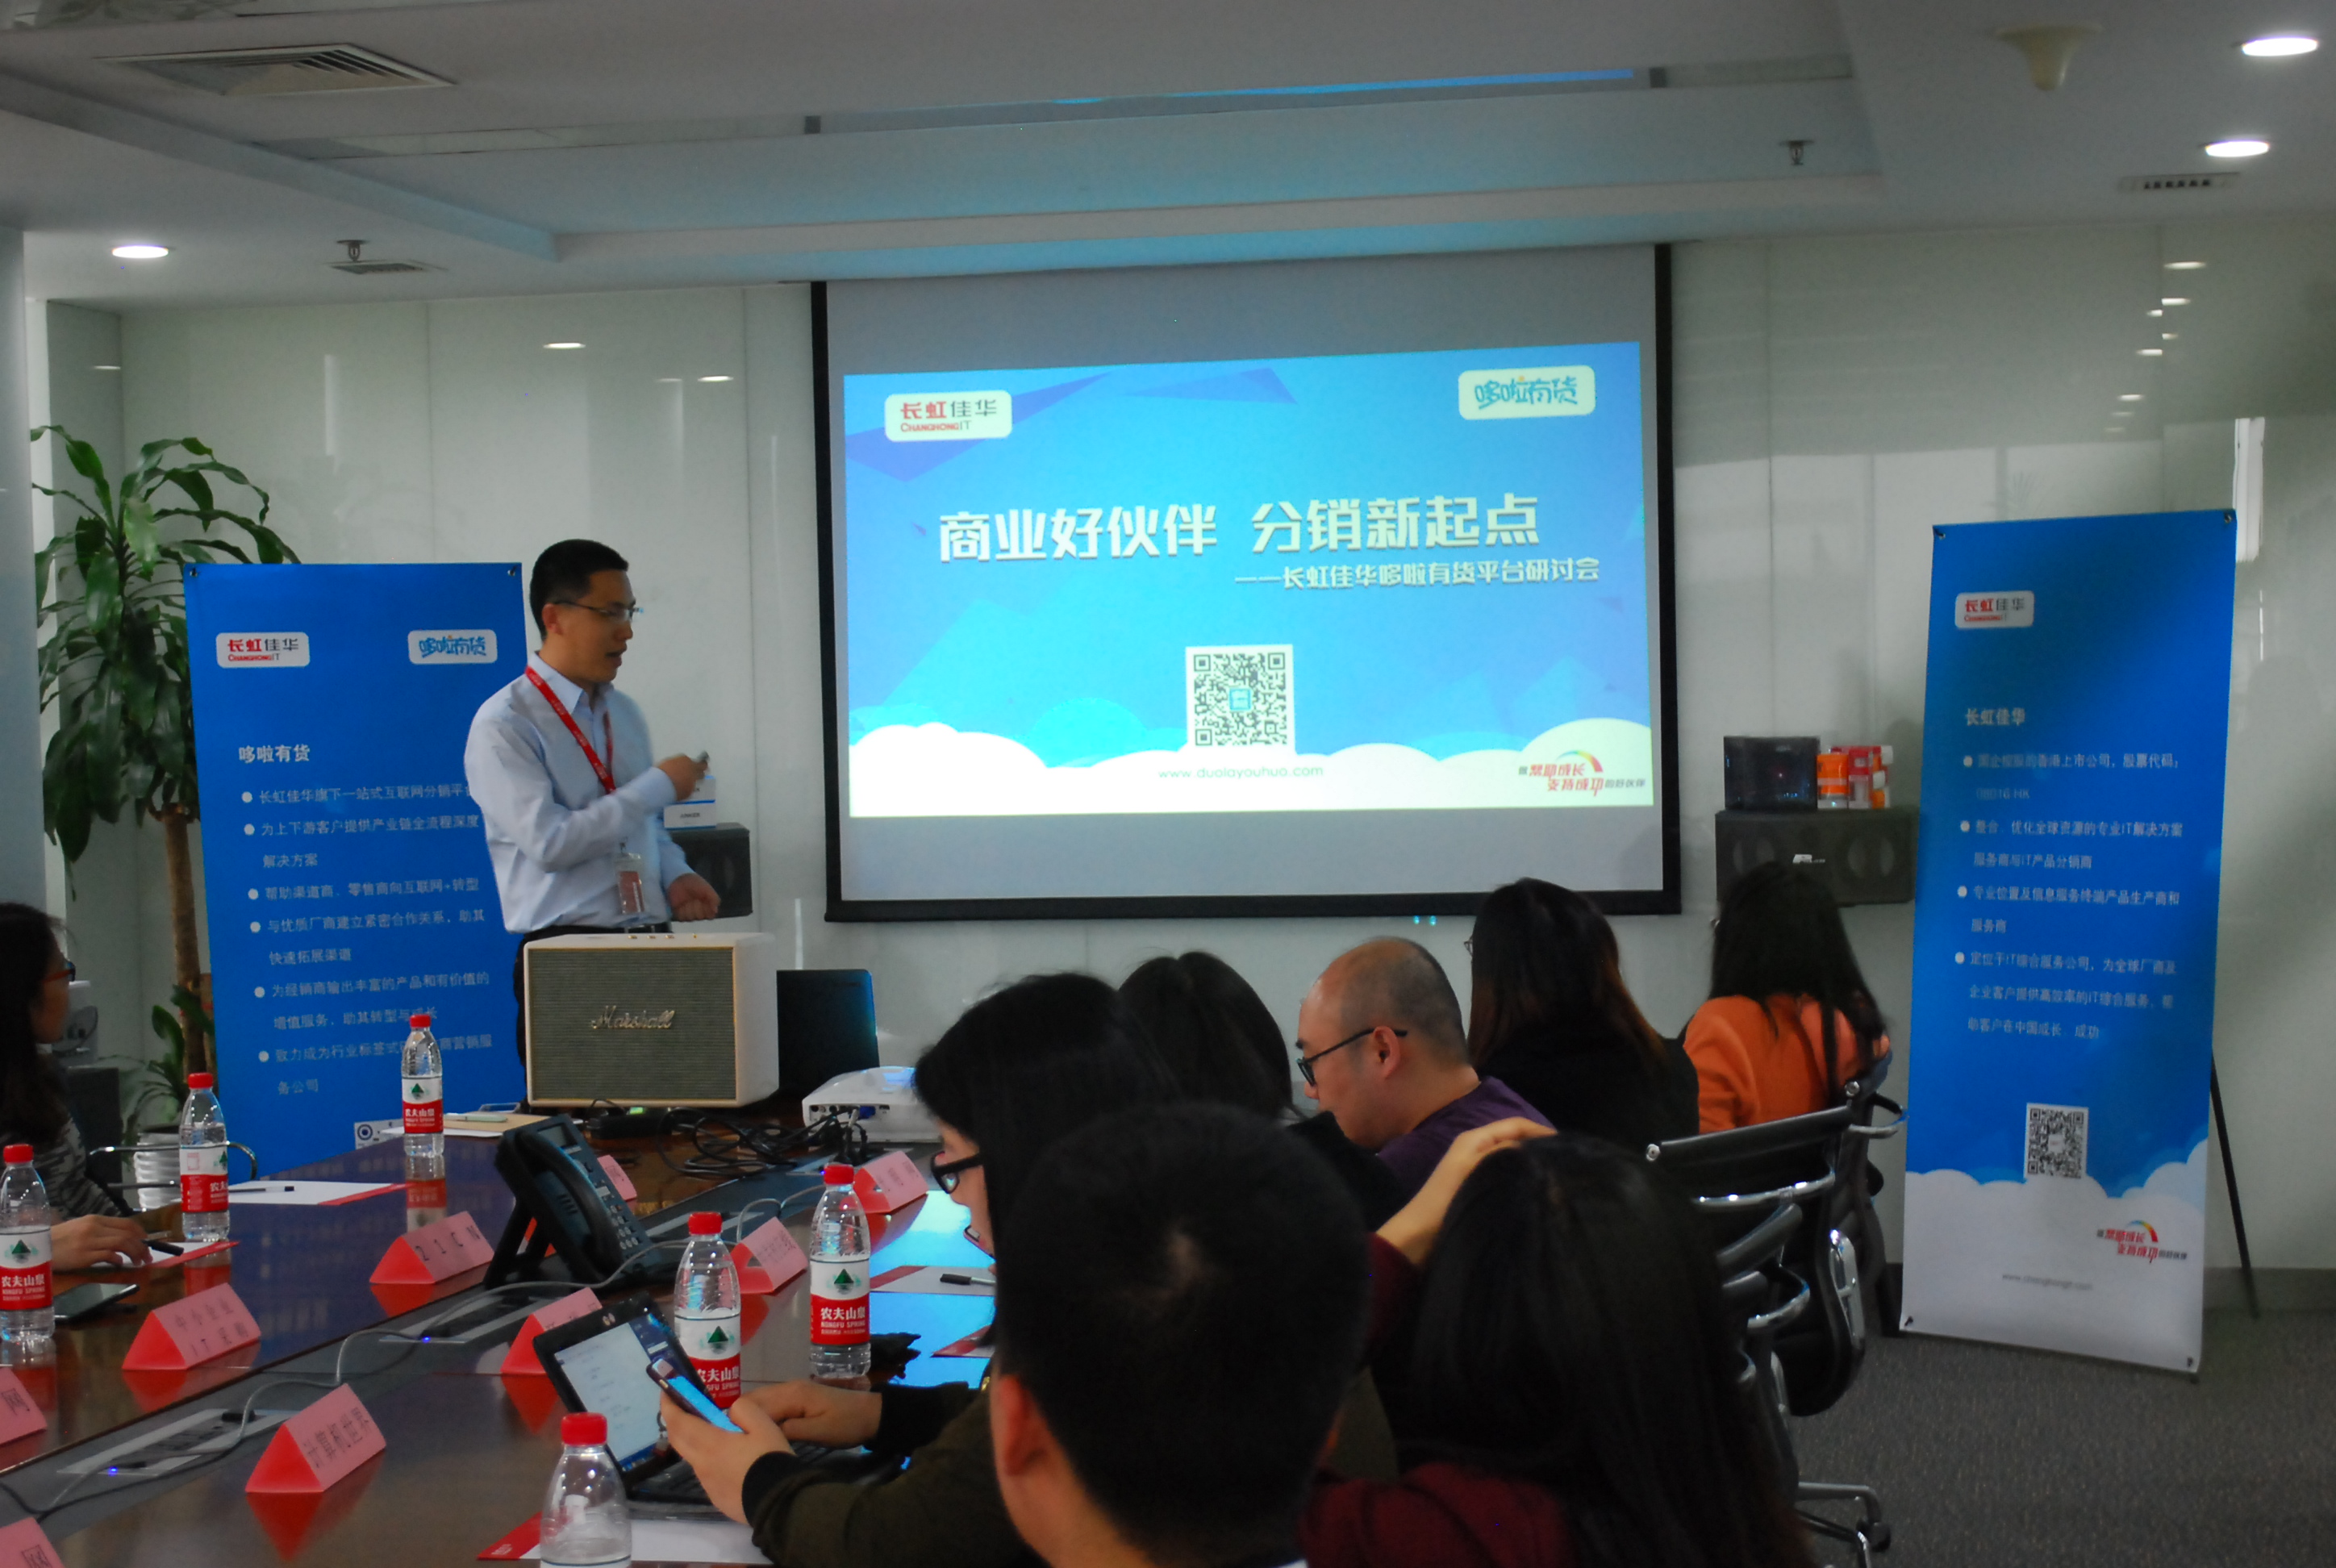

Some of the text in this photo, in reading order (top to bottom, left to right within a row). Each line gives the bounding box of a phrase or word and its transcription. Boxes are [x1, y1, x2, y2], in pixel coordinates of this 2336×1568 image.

[1475, 375, 1578, 410] 哆啦有货
[899, 398, 998, 419] 长虹佳华
[939, 492, 1540, 563] 商业好伙伴 分销新起点
[1964, 597, 2025, 613] 长虹佳华
[227, 638, 299, 652] 长虹佳华
[1964, 707, 2026, 727] 长虹佳华
[238, 744, 311, 764] 哆啦有货
[1158, 765, 1324, 780] www.duolayouhuo.com
[263, 853, 319, 869] 解决方案
[590, 1004, 675, 1030] Marshall
[1, 1273, 45, 1287] 农夫山泉
[820, 1306, 866, 1320] 农夫山泉
